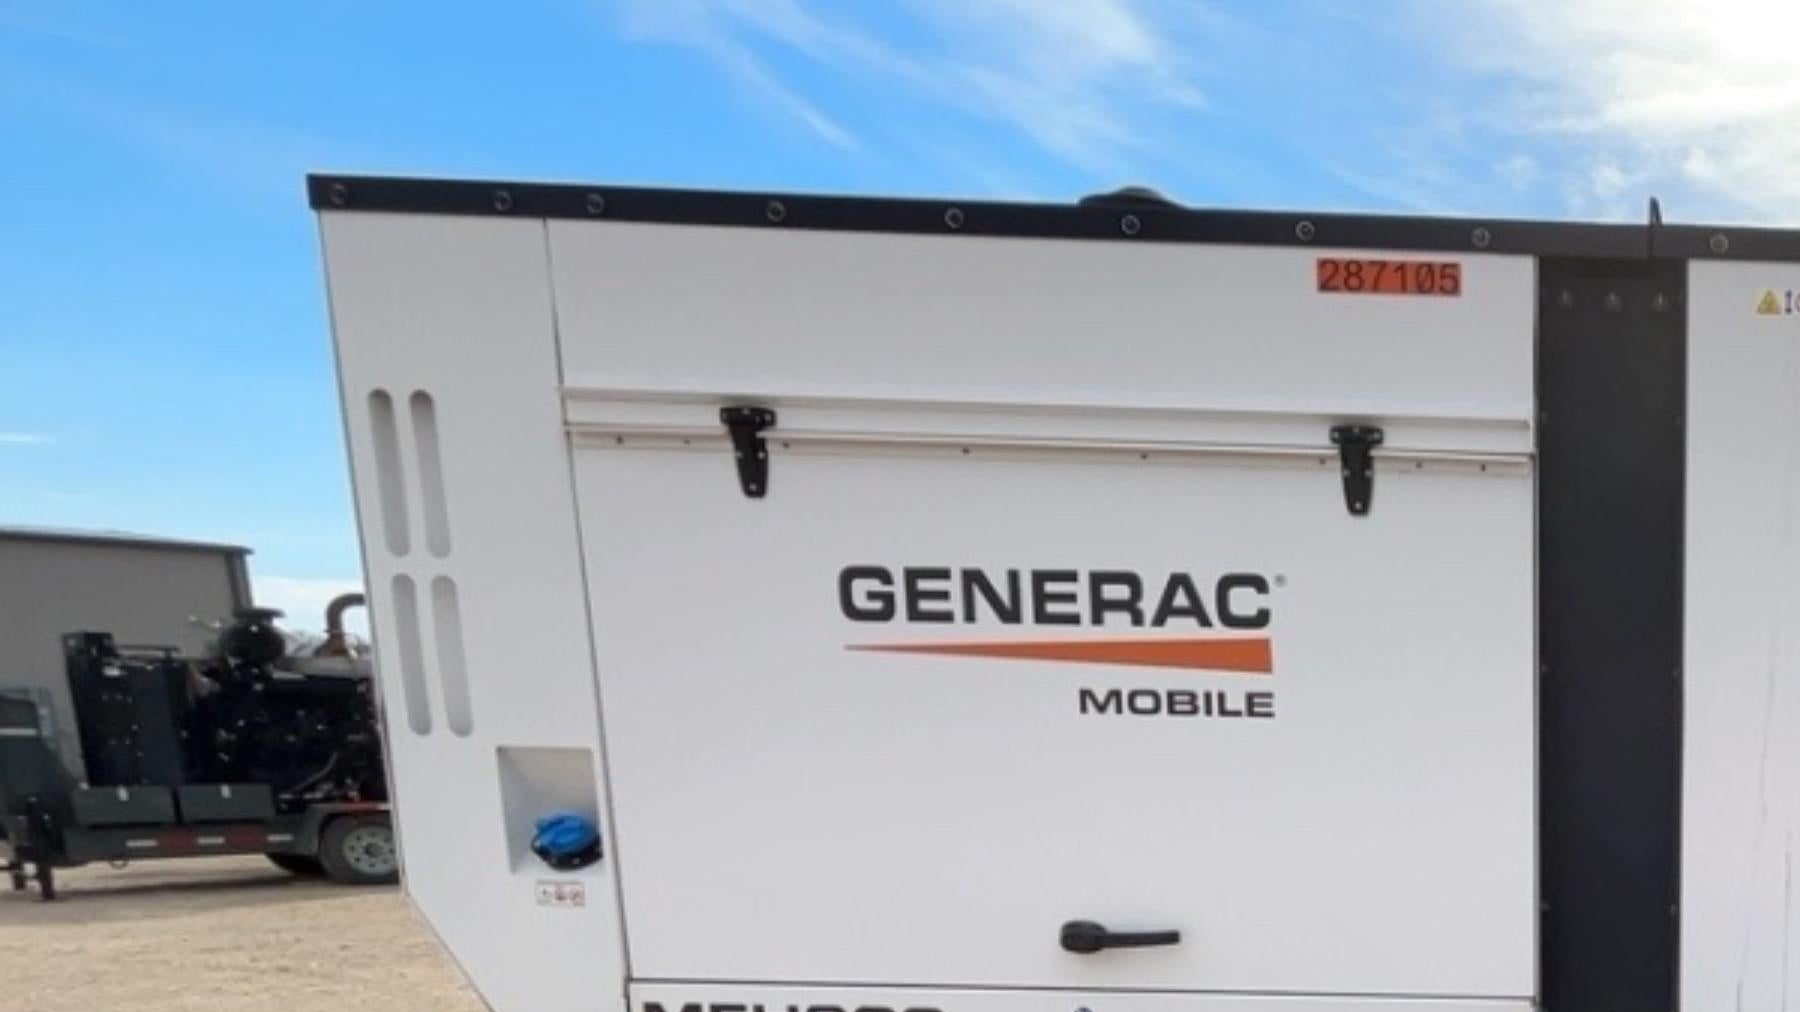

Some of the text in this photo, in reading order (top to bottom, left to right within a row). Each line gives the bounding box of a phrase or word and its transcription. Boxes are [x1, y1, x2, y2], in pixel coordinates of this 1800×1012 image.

[1318, 258, 1462, 297] 287105
[838, 564, 1272, 631] GENERAC
[1078, 688, 1276, 719] MOBILE
